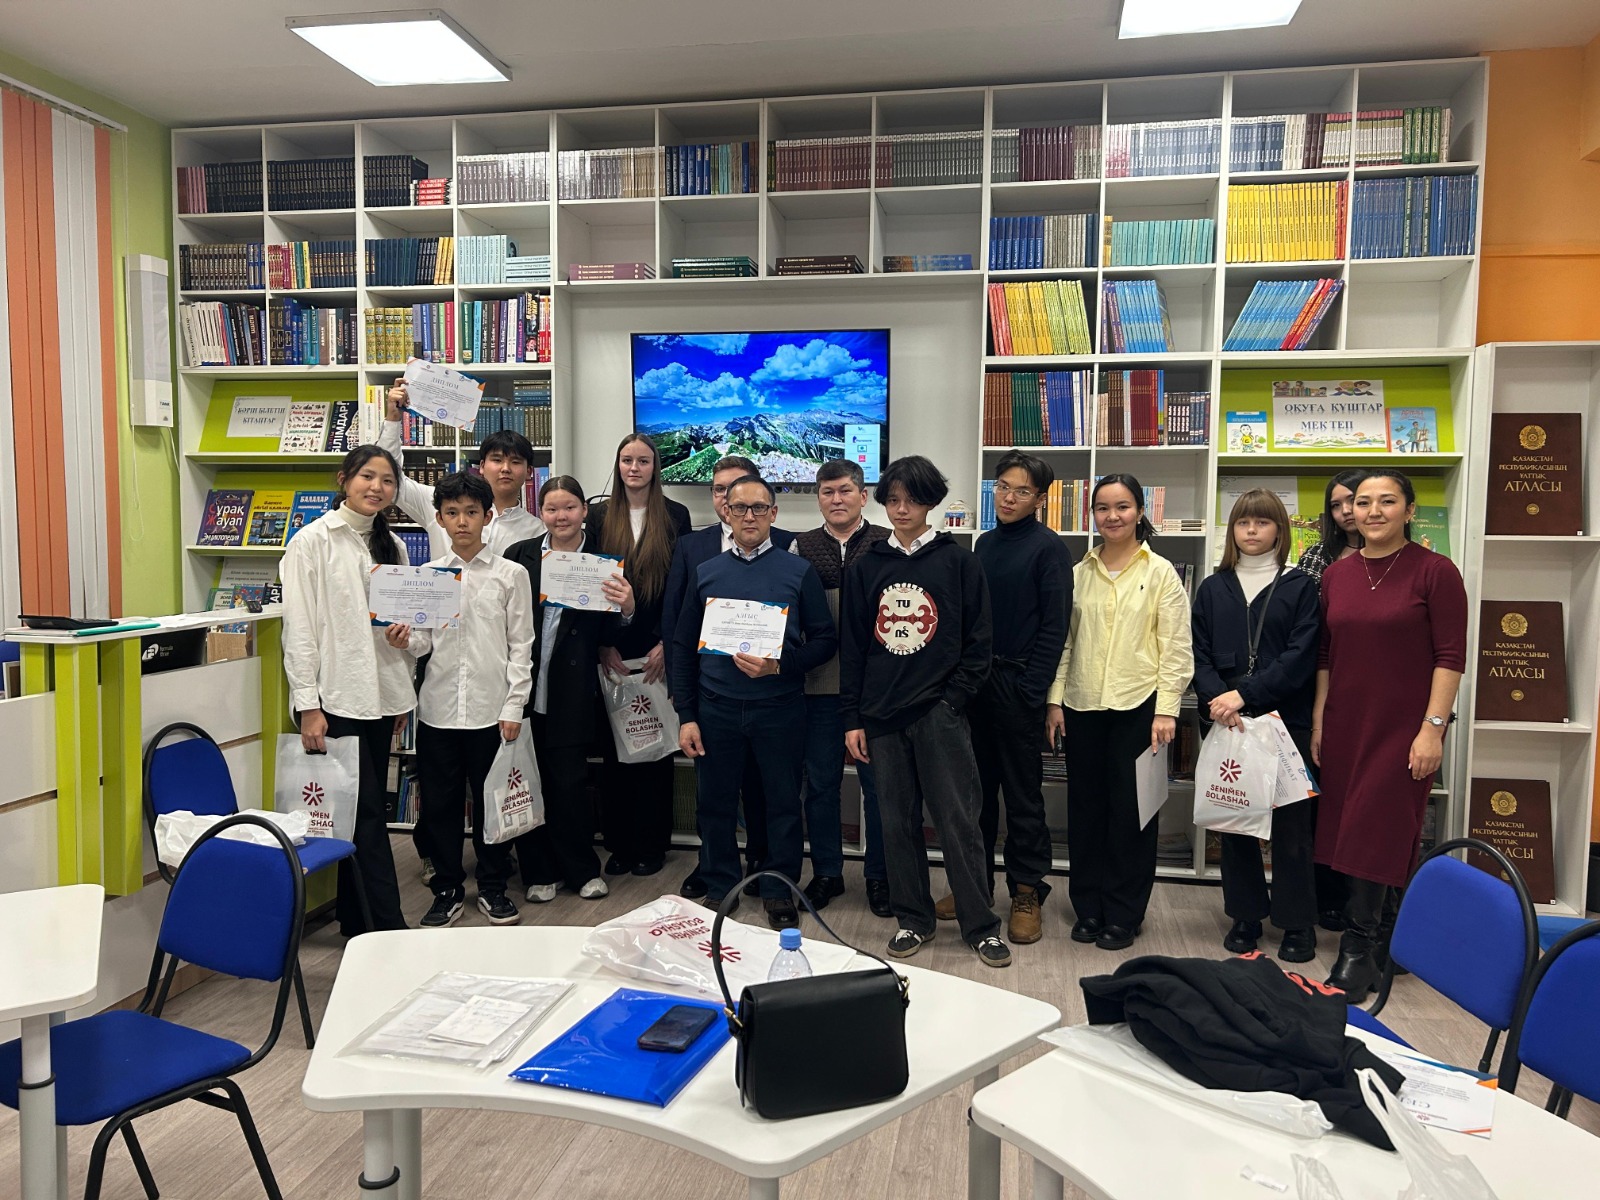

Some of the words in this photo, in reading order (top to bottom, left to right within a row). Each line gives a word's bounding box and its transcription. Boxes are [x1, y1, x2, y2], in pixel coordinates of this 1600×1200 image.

[1504, 480, 1562, 492] АТЛАСЫ
[299, 495, 330, 503] БАЛАЛАР
[209, 503, 244, 516] Сұрақ
[206, 514, 243, 528] Жауап
[402, 580, 434, 588] ДИПЛОМ
[896, 599, 911, 608] TU
[1495, 642, 1536, 650] ҚАЗАҚСТАН
[1482, 650, 1550, 659] РЕСПУБЛИКАСЫНЫҢ
[1488, 666, 1545, 680] АТЛАСЫ
[625, 724, 664, 734] BOLASHAQ
[501, 795, 534, 813] BOLASHAQ
[1205, 790, 1251, 808] BOLASHAQ
[311, 819, 334, 828] SHAQ
[1485, 820, 1525, 829] ҚАЗАҚСТАН
[1472, 828, 1539, 839] РЕСПУБЛИКАСЫНЫҢ
[648, 917, 705, 937] BOLASHAQ
